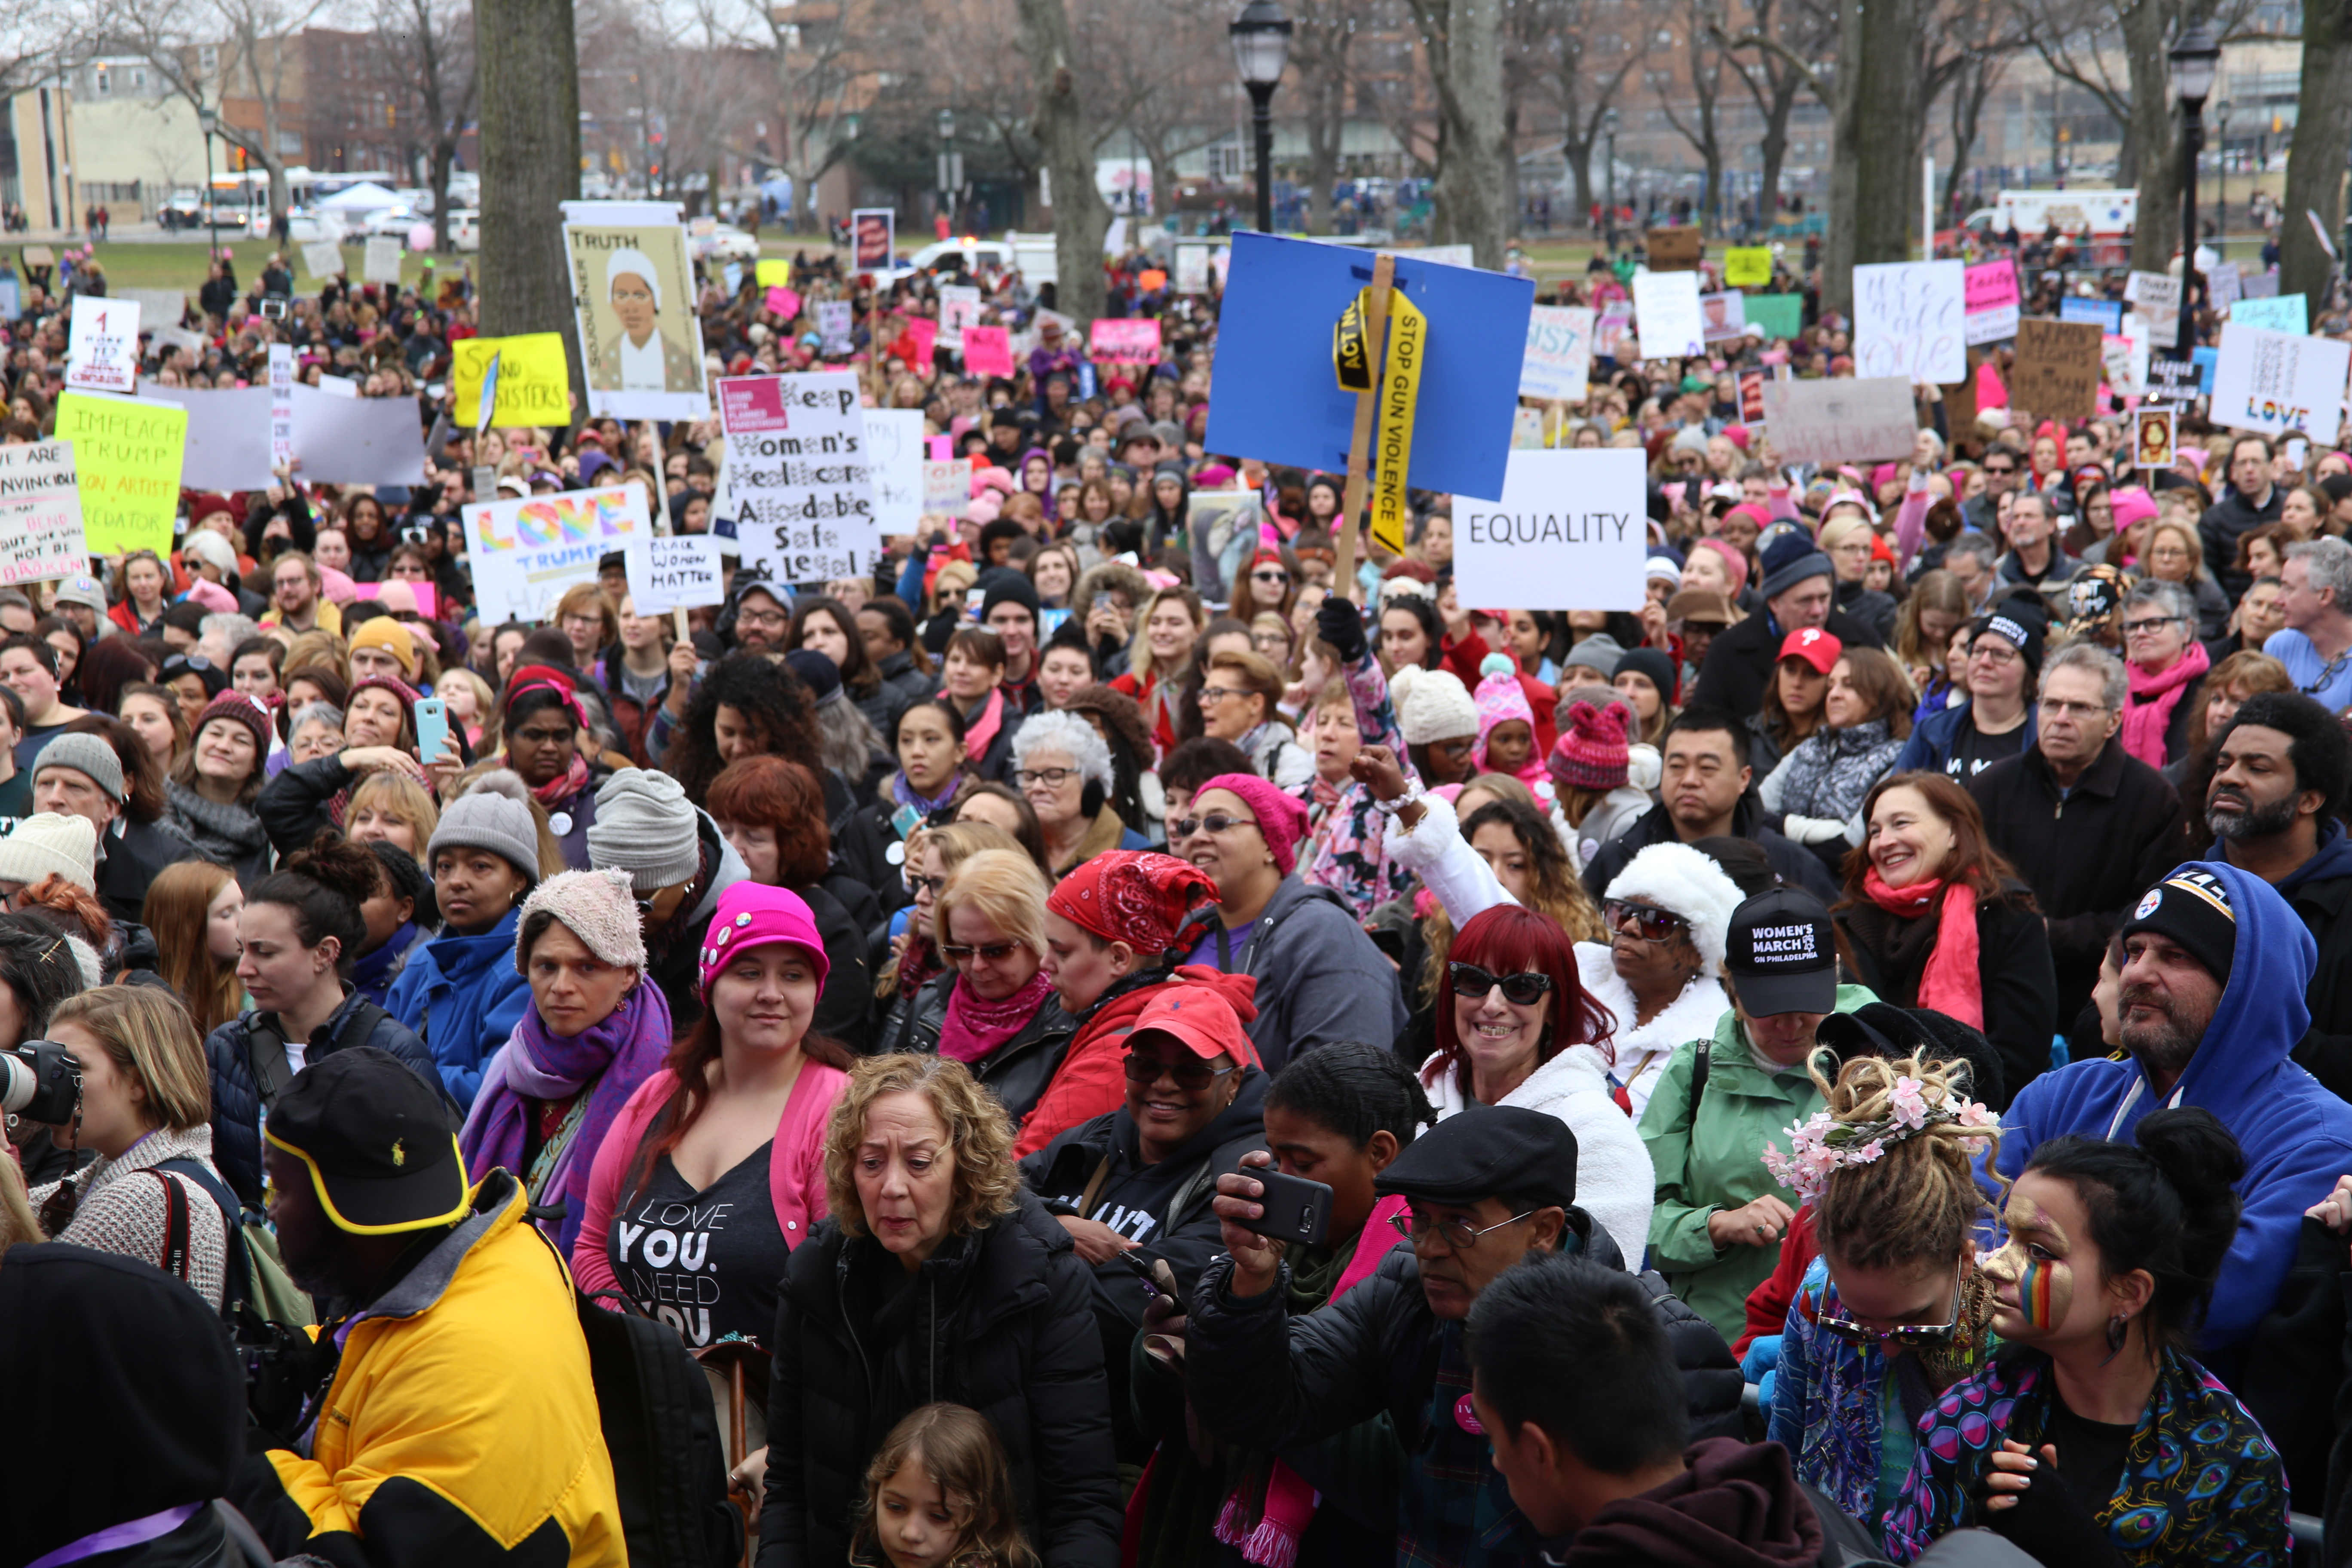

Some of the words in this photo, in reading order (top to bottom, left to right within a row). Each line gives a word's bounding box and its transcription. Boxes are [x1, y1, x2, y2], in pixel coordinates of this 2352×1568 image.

[570, 230, 640, 251] TRUTH
[577, 259, 600, 369] SOJOURNER
[1344, 331, 1362, 369] ACT
[1397, 315, 1418, 370] STOP
[779, 381, 854, 416] Keep
[1389, 375, 1409, 420] GUN
[72, 408, 181, 444] IMPEACH
[728, 408, 768, 420] PLANNED
[729, 416, 786, 430] PARENTHOOD
[2246, 395, 2310, 431] LOVE
[27, 446, 60, 463] ARE
[81, 437, 168, 466] TRUMP
[732, 430, 858, 457] Women's
[0, 470, 77, 494] NVINCIBLE
[1380, 424, 1403, 521] VIOLENCE
[116, 475, 171, 498] ARTIST
[82, 503, 160, 533] REDATOR
[478, 491, 635, 553] LOVE
[1470, 513, 1629, 547] EQUALITY
[0, 535, 27, 553] BUT
[650, 539, 695, 552] BLACK
[775, 523, 839, 551] Safe
[15, 546, 42, 563] NOT
[53, 542, 71, 555] BE
[515, 542, 611, 570] TRUMPS
[651, 555, 706, 568] WOMEN
[651, 571, 712, 589] MATTER
[1988, 623, 2018, 640] MARCH
[1752, 924, 1813, 939] WOMEN'S
[1752, 939, 1801, 953] MARCH
[1754, 956, 1766, 964] ON
[1766, 951, 1818, 963] PHILADELPHIA
[19, 1047, 36, 1055] Canon
[638, 1198, 734, 1230] LOVE
[619, 1221, 717, 1272] YOU.
[172, 1260, 181, 1278] ark
[632, 1268, 720, 1305] NEED
